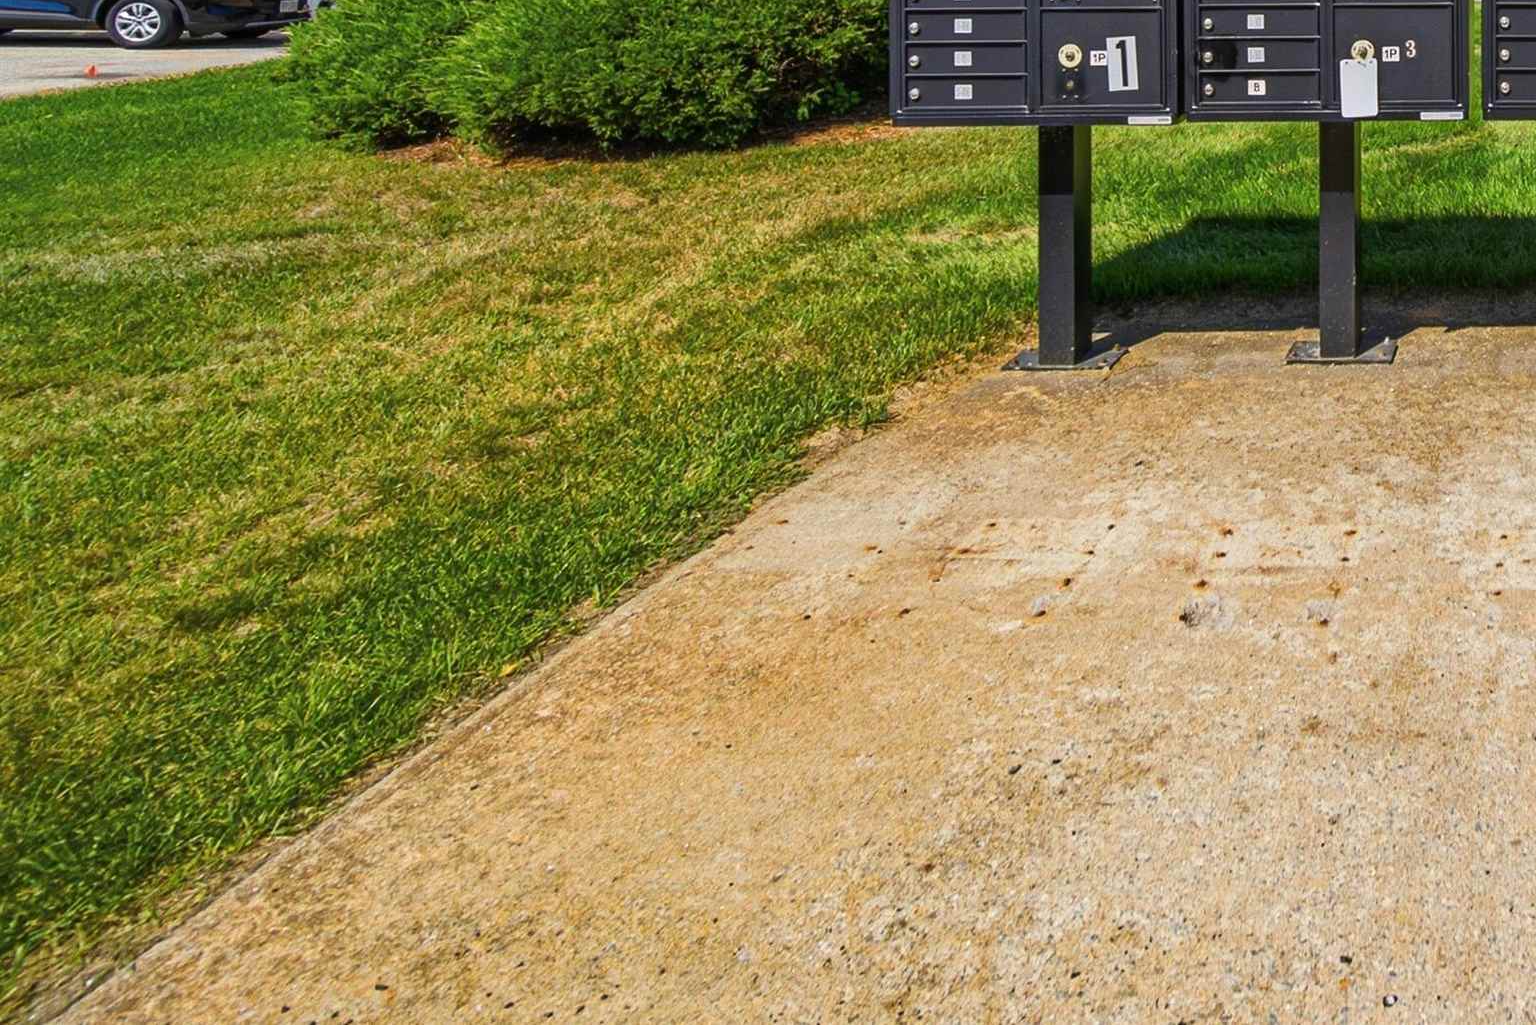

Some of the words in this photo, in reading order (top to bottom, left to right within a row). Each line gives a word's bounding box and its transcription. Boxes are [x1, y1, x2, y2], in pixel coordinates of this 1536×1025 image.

[1385, 48, 1398, 59] 1P
[1405, 39, 1416, 58] 3
[1116, 40, 1129, 87] 1
